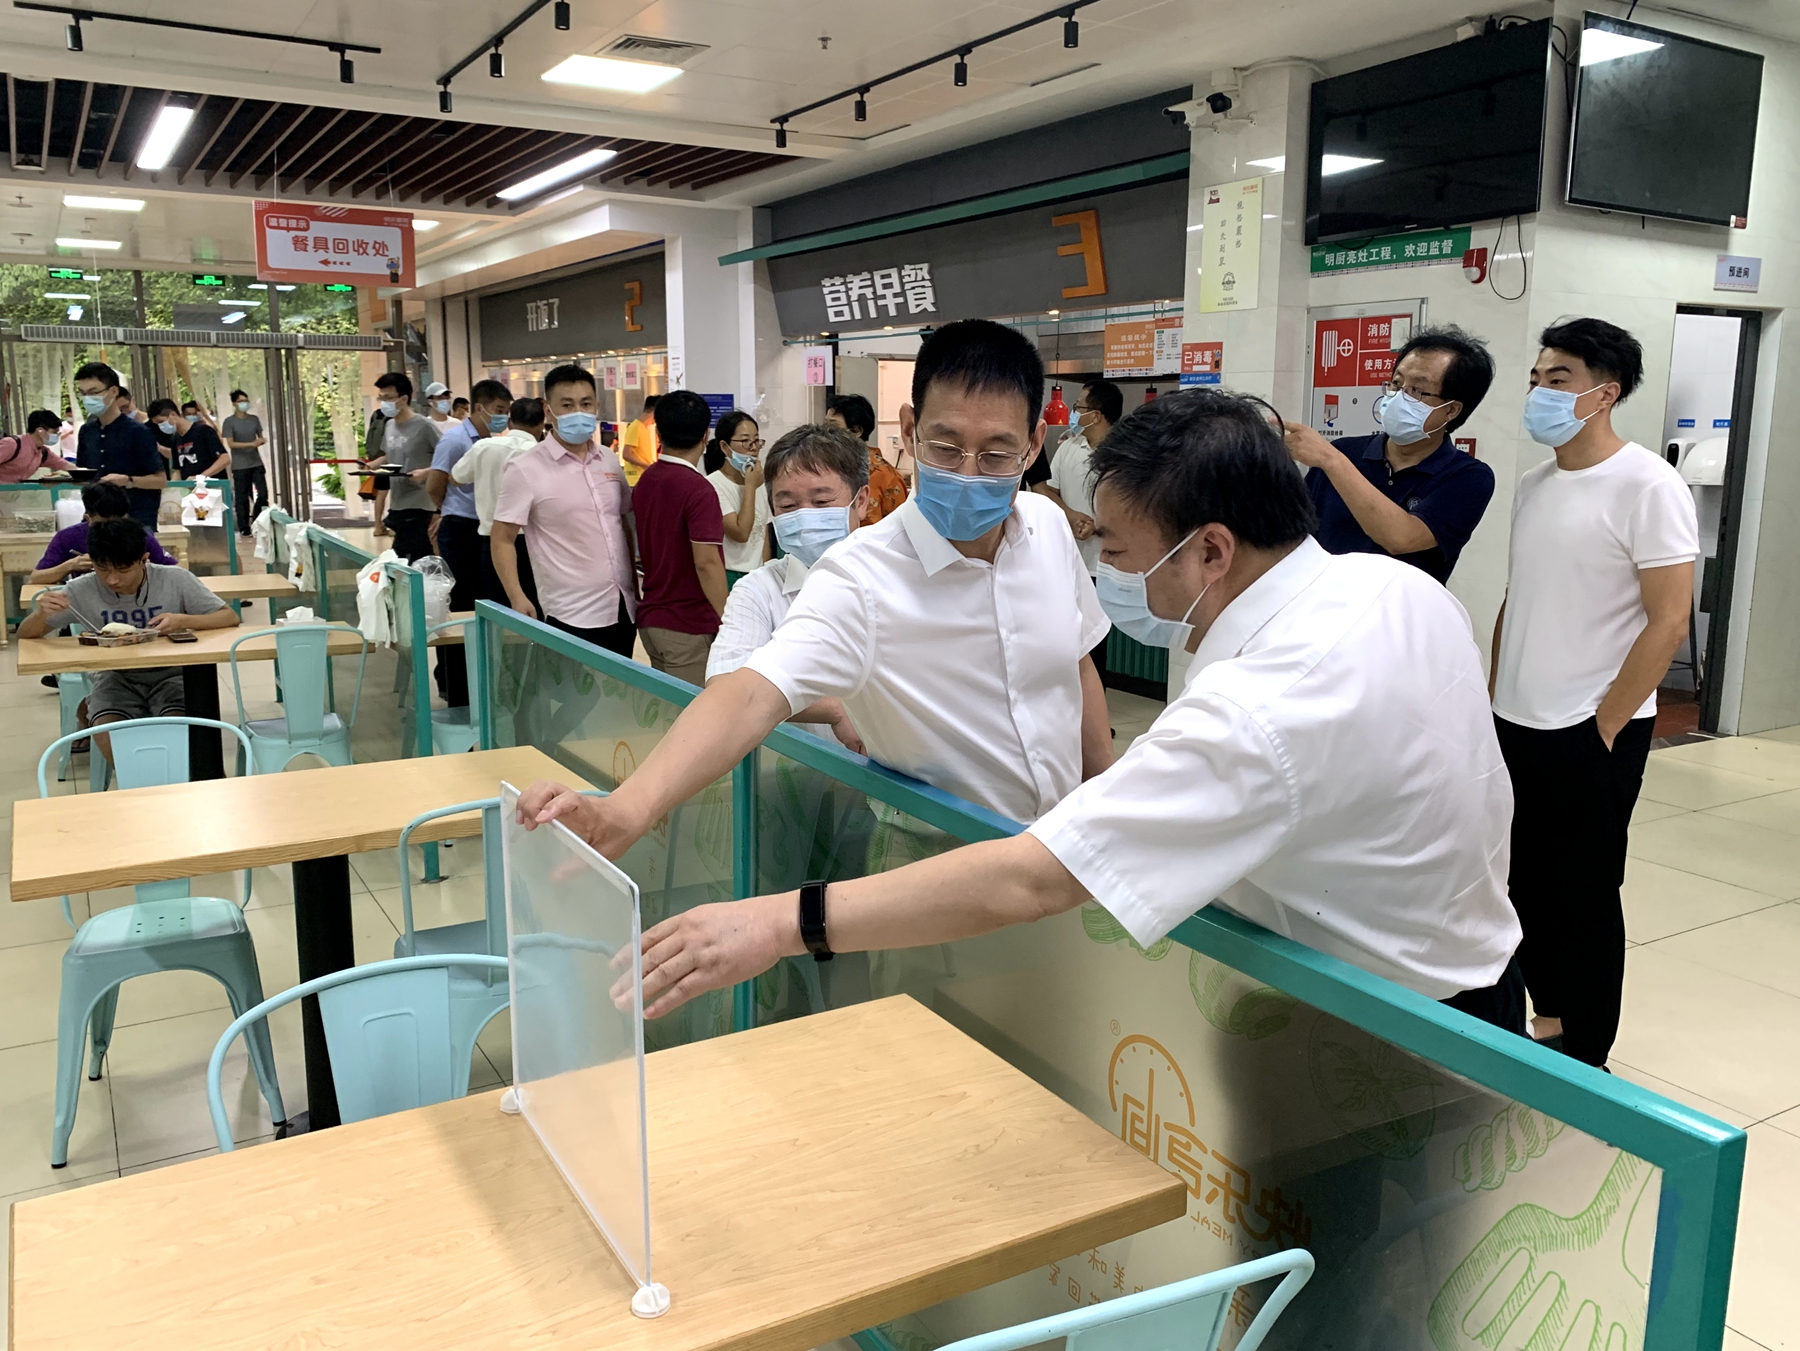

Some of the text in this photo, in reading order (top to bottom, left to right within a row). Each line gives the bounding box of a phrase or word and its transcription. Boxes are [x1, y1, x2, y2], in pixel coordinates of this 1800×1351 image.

[291, 234, 389, 258] 餐具回收处
[1052, 209, 1108, 298] 3
[1324, 239, 1453, 267] 明厨亮灶工程，欢迎监督
[624, 280, 643, 332] 2
[820, 262, 937, 323] 营养早餐
[526, 297, 560, 332] 开饭了
[1367, 322, 1390, 337] 消防
[1184, 350, 1212, 364] 已消毒
[1364, 358, 1397, 371] 使用方
